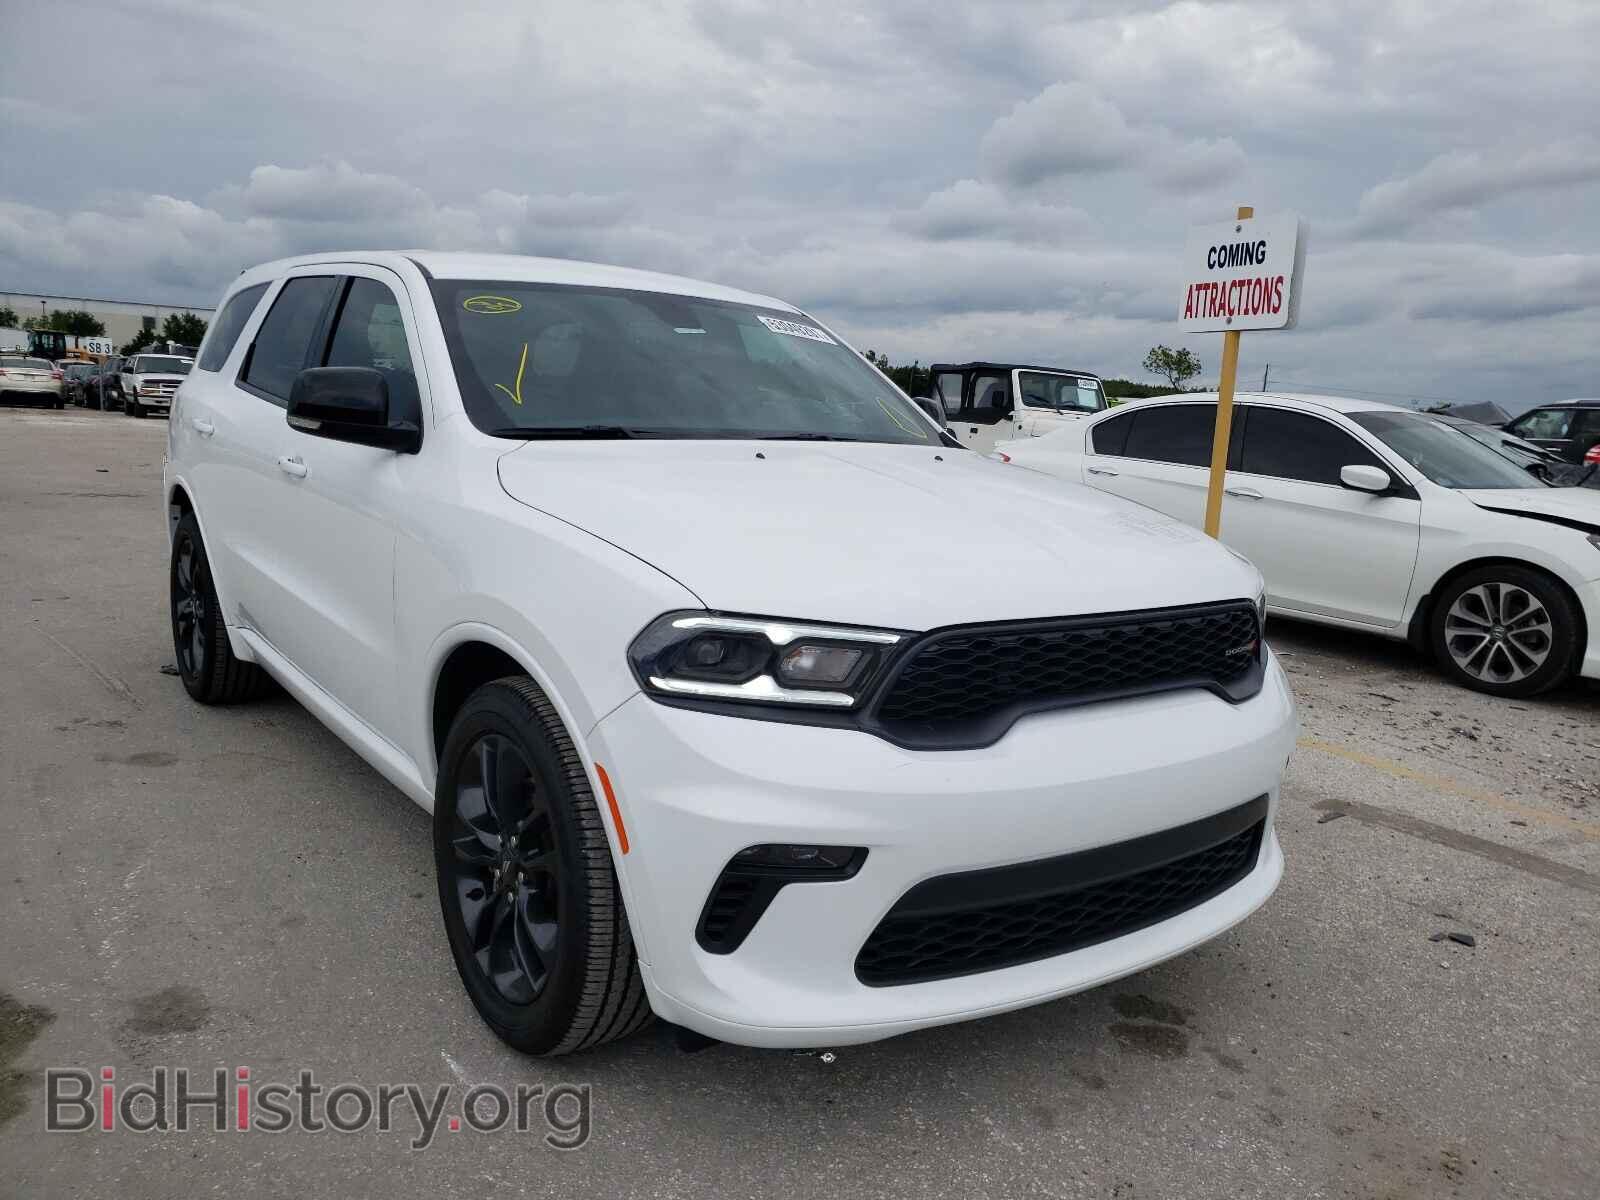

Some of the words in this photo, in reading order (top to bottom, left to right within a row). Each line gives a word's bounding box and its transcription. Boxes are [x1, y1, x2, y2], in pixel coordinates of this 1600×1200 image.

[1207, 240, 1266, 269] COMING
[1184, 275, 1284, 319] ATTRACTIONS
[89, 342, 101, 353] SB
[104, 343, 110, 353] 3
